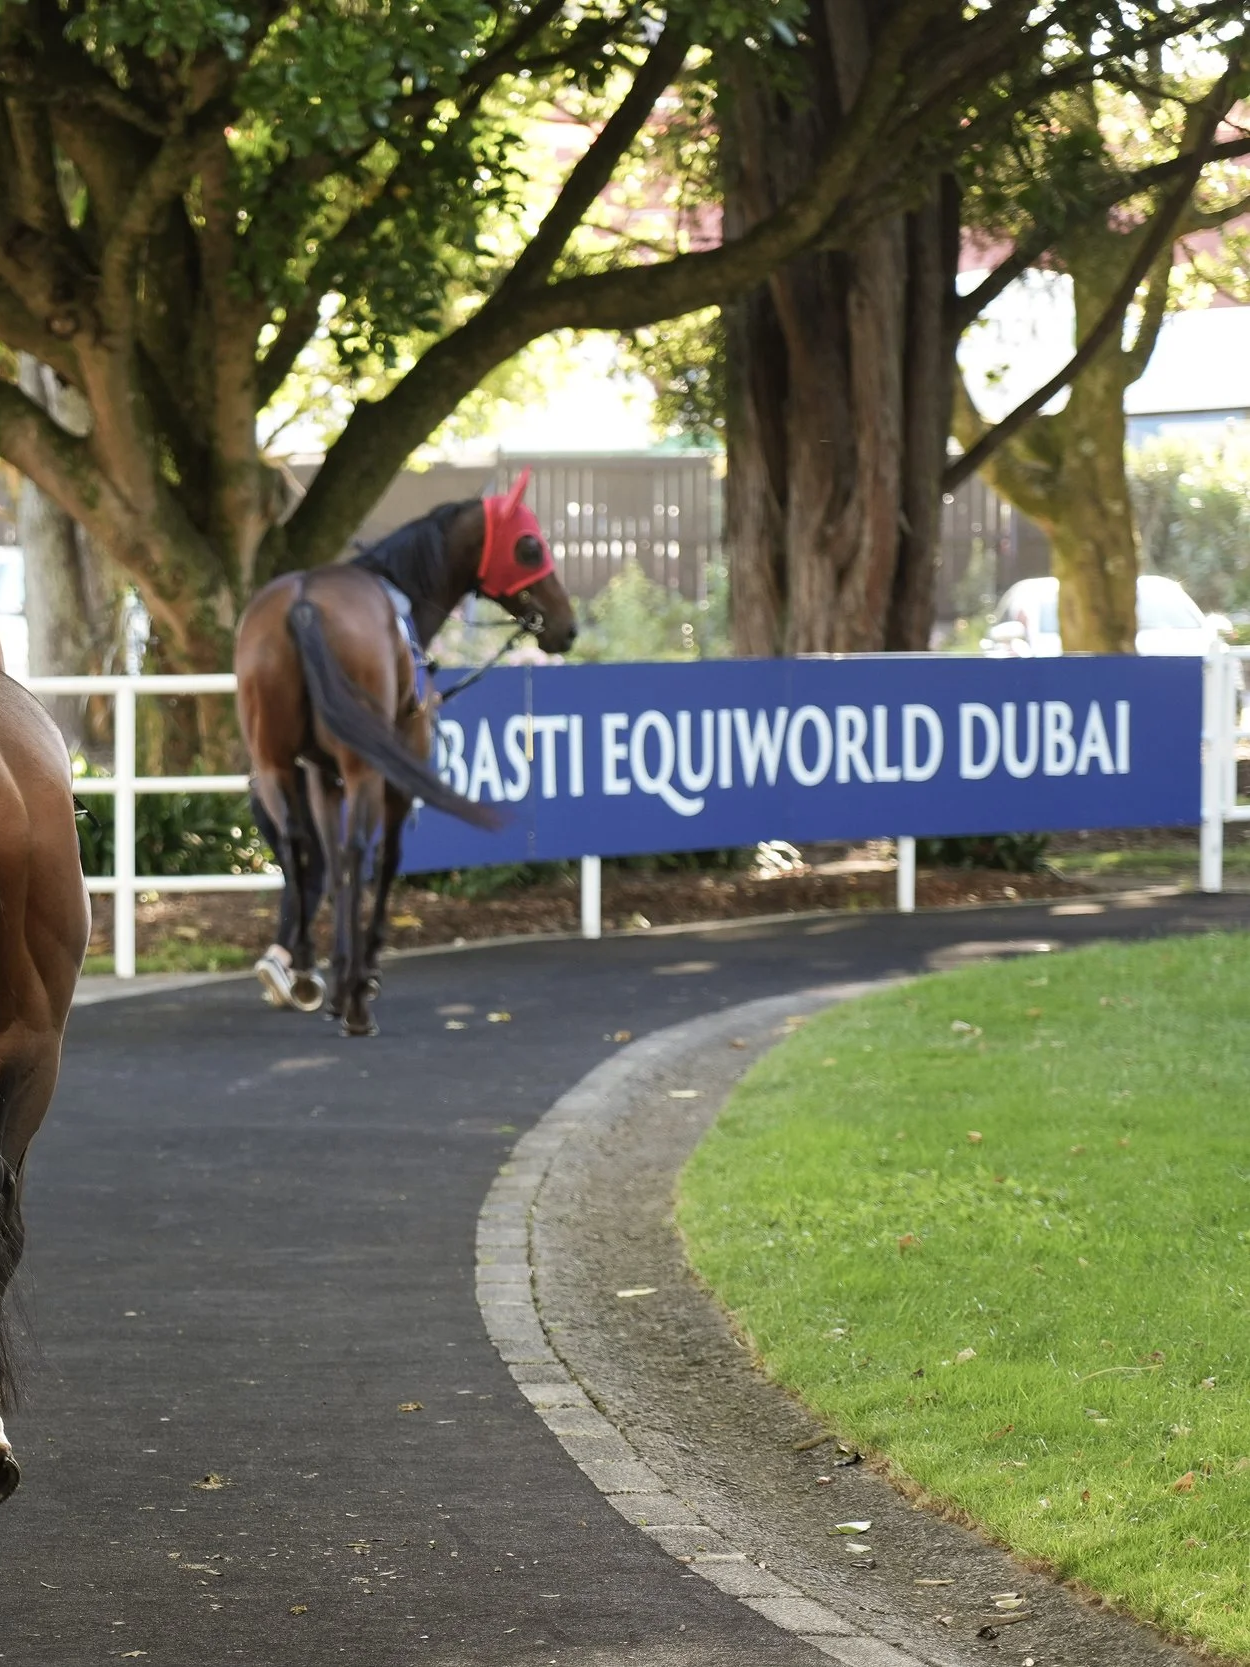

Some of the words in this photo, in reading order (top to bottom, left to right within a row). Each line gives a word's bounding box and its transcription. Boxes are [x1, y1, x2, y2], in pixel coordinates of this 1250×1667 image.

[437, 713, 584, 803] BASTI
[601, 704, 944, 816] EQUIWORLD
[959, 699, 1130, 780] DUBAI
